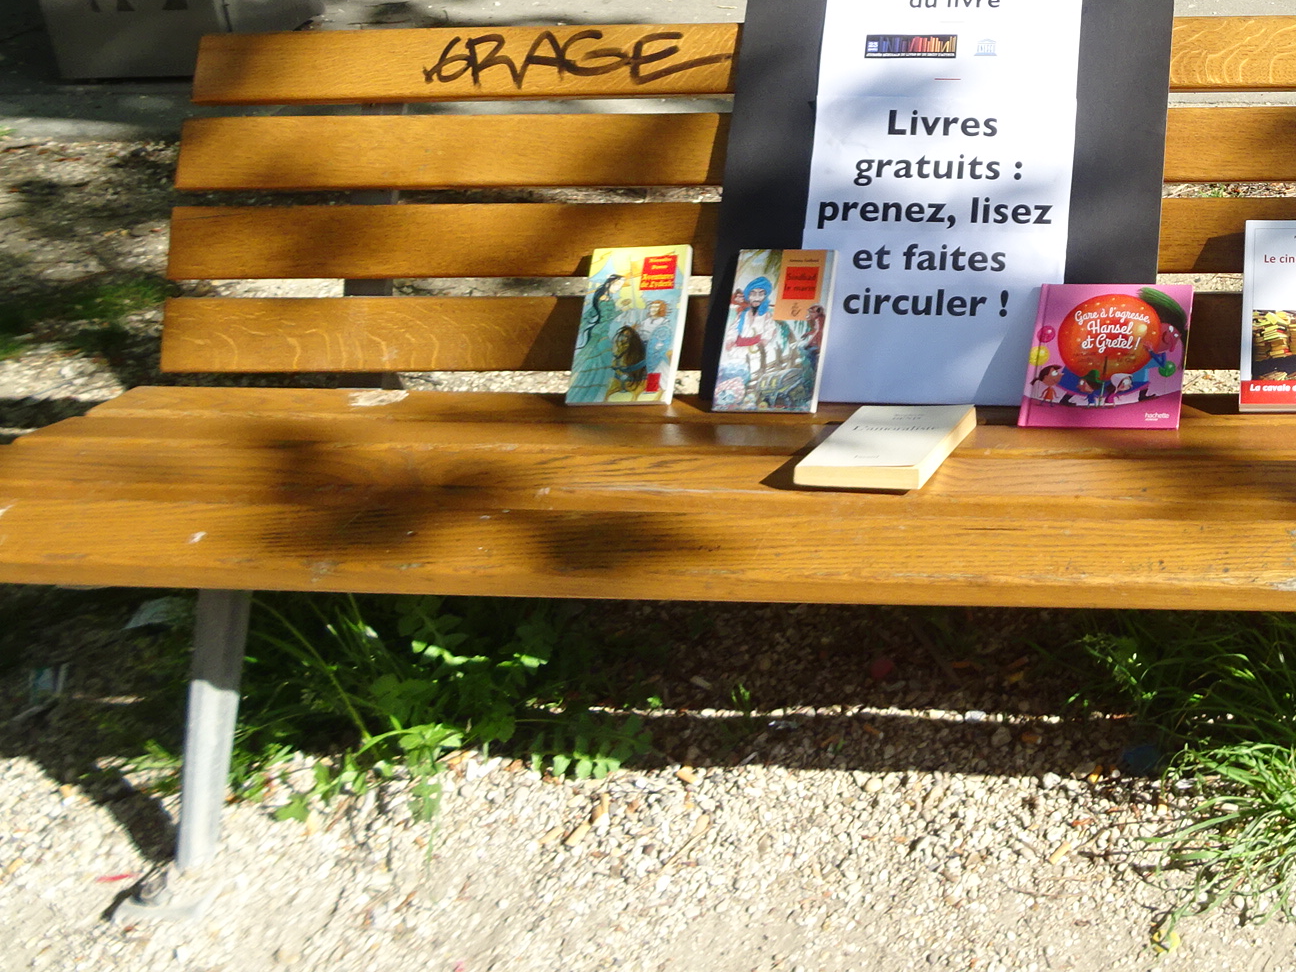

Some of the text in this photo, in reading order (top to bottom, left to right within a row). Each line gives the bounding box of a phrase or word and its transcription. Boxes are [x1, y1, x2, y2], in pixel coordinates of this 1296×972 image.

[887, 109, 998, 137] Livres
[853, 153, 1023, 186] gratuits :
[817, 196, 1054, 229] prenez, lisez
[852, 243, 1006, 272] et faites
[1263, 254, 1276, 263] Le
[843, 287, 1009, 318] circuler !
[1074, 307, 1151, 325] Gare à l'ogresse,
[1086, 320, 1134, 335] Hansel
[1081, 334, 1141, 354] et Gretel !
[1250, 384, 1261, 392] La
[1262, 384, 1291, 392] cavale
[1144, 412, 1170, 420] hachette
